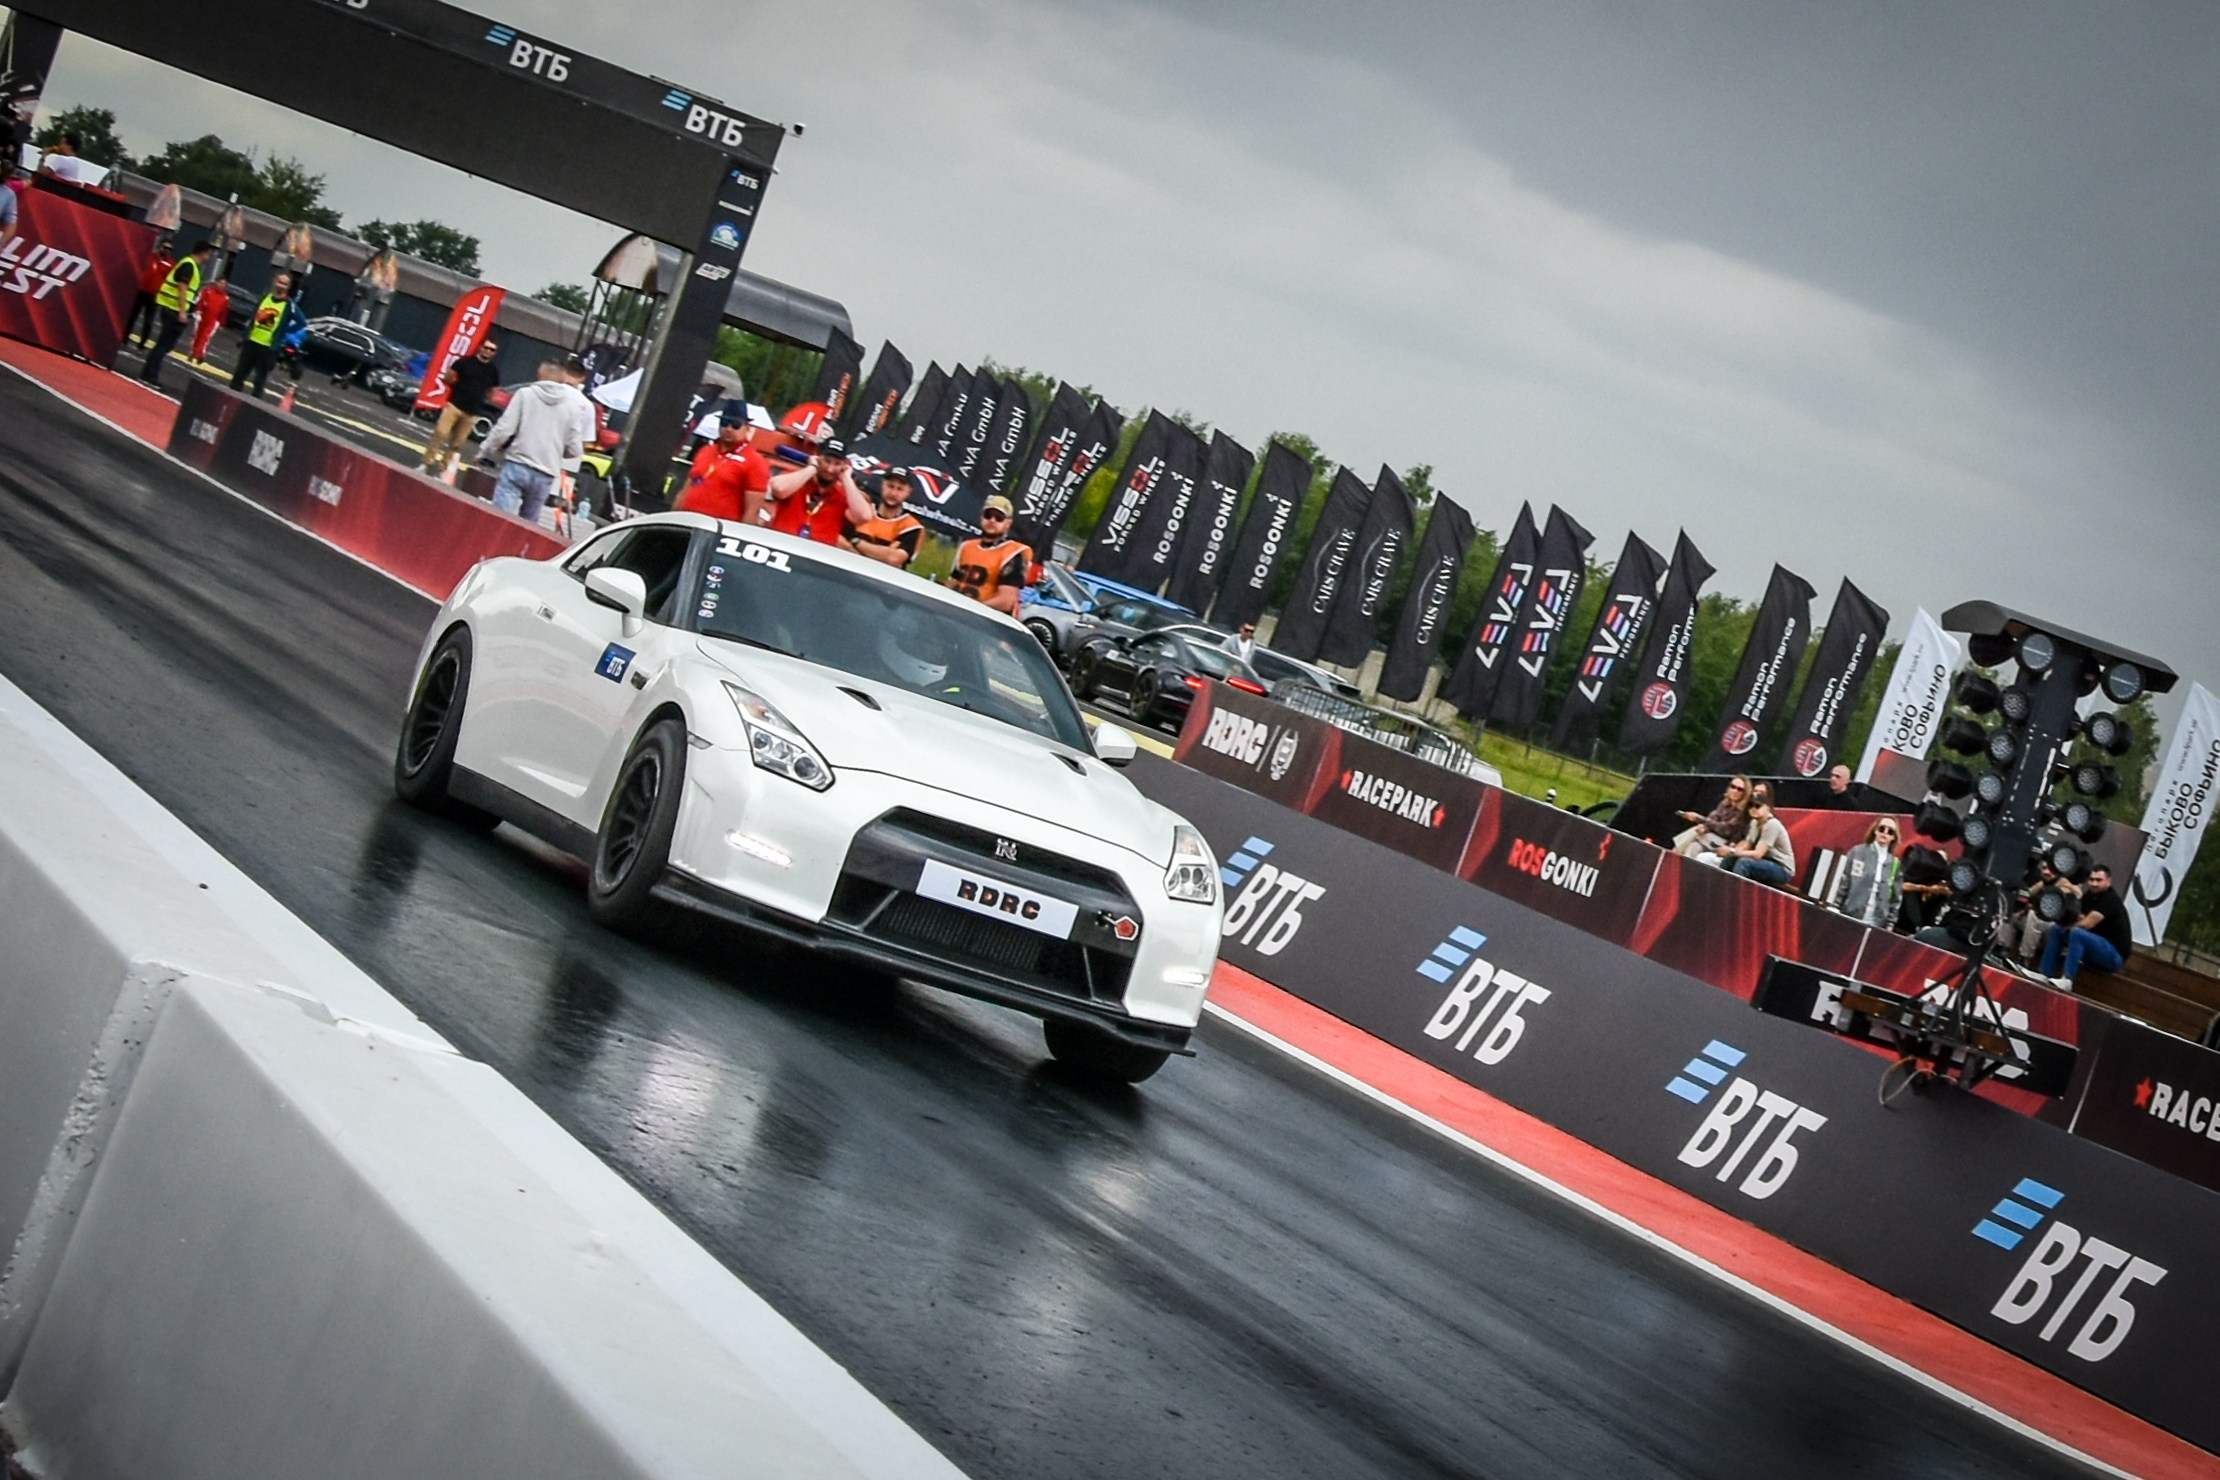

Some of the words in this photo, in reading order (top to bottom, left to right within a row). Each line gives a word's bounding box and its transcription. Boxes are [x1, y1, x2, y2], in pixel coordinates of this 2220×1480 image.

[509, 39, 572, 83] ВТБ
[685, 104, 746, 147] ВТБ
[737, 174, 759, 190] ВТБ
[0, 235, 91, 282] LIM
[971, 396, 997, 443] GmbH
[1001, 406, 1027, 453] GmbH
[1018, 426, 1069, 515] VISSOL
[1138, 460, 1166, 505] WHEELS
[1101, 455, 1159, 545] VISSOL
[716, 537, 792, 573] 101
[1312, 575, 1335, 614] CARS
[1327, 528, 1356, 576] CRAVE
[1361, 577, 1384, 616] CARS
[1375, 528, 1401, 577] CRAVE
[1416, 605, 1439, 645] CARS
[1431, 555, 1455, 605] CRAVE
[1618, 599, 1651, 659] PERFORMANCE
[1656, 623, 1682, 678] Ramon
[1741, 662, 1769, 717] Ramon
[1809, 677, 1838, 734] Ramon
[1909, 664, 1946, 749] СОФЬИНО
[1202, 706, 1269, 765] RDRC
[1892, 704, 1918, 752] КОВО
[1347, 770, 1438, 828] RACEPARK
[2155, 782, 2193, 860] БЫКОВО
[1508, 838, 1600, 898] ROSGONKI
[956, 879, 1041, 920] RDRC
[1222, 863, 1327, 956] ВТБ
[1423, 957, 1552, 1065] ВТБ
[1677, 1077, 1829, 1200] ВТБ
[1990, 1220, 2169, 1362] ВТБ
